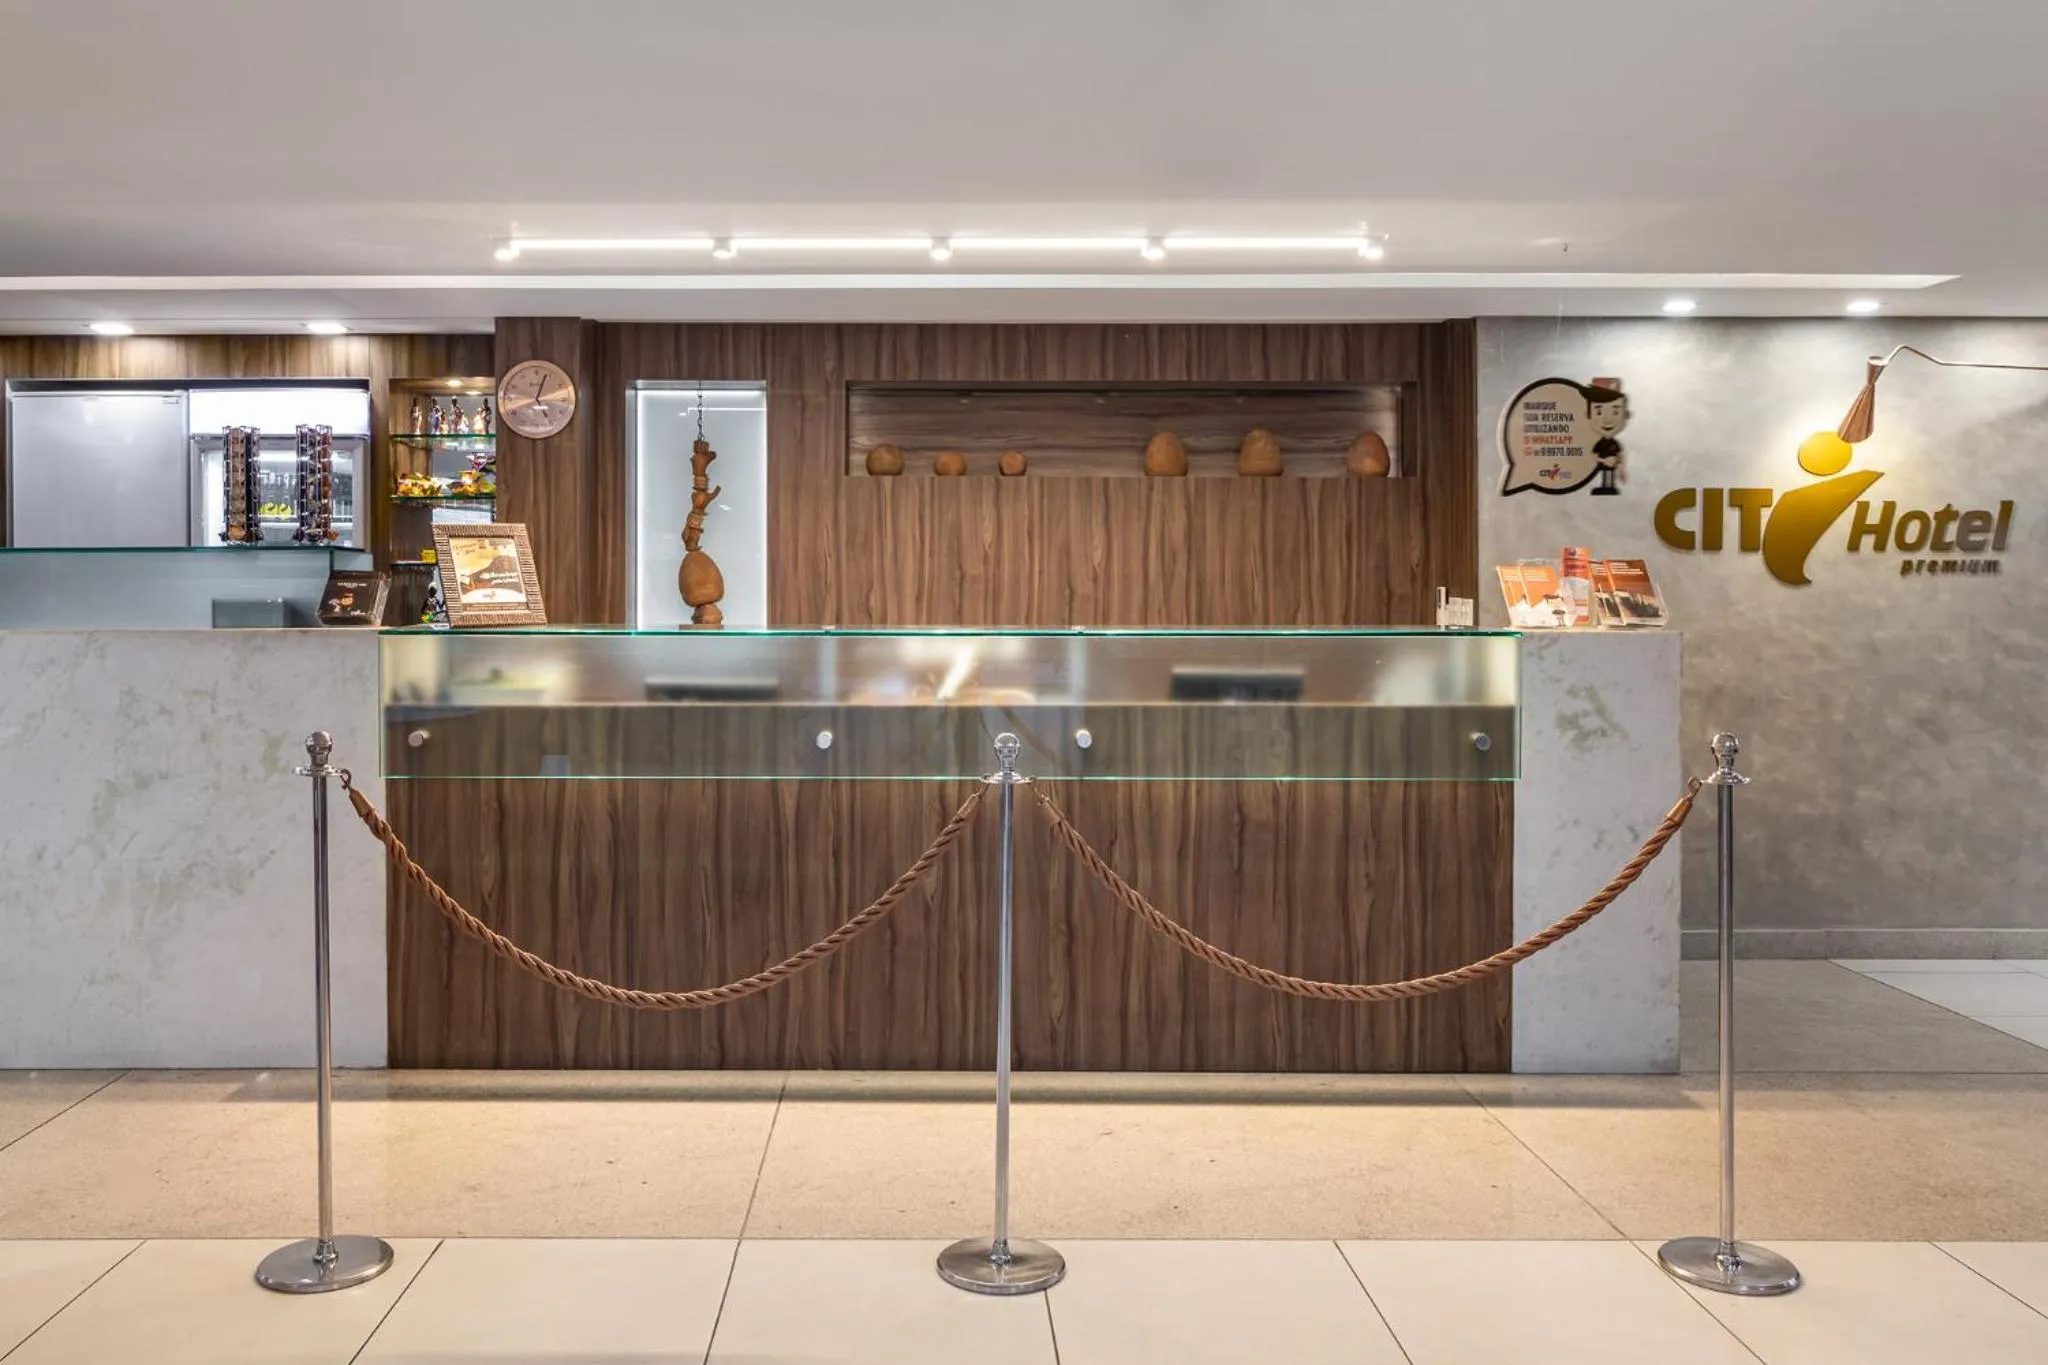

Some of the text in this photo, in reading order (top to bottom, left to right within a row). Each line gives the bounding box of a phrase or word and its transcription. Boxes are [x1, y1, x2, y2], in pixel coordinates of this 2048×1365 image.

[1541, 413, 1574, 422] RESERVA
[1847, 500, 2015, 552] Hotel
[1900, 557, 2001, 577] premium
